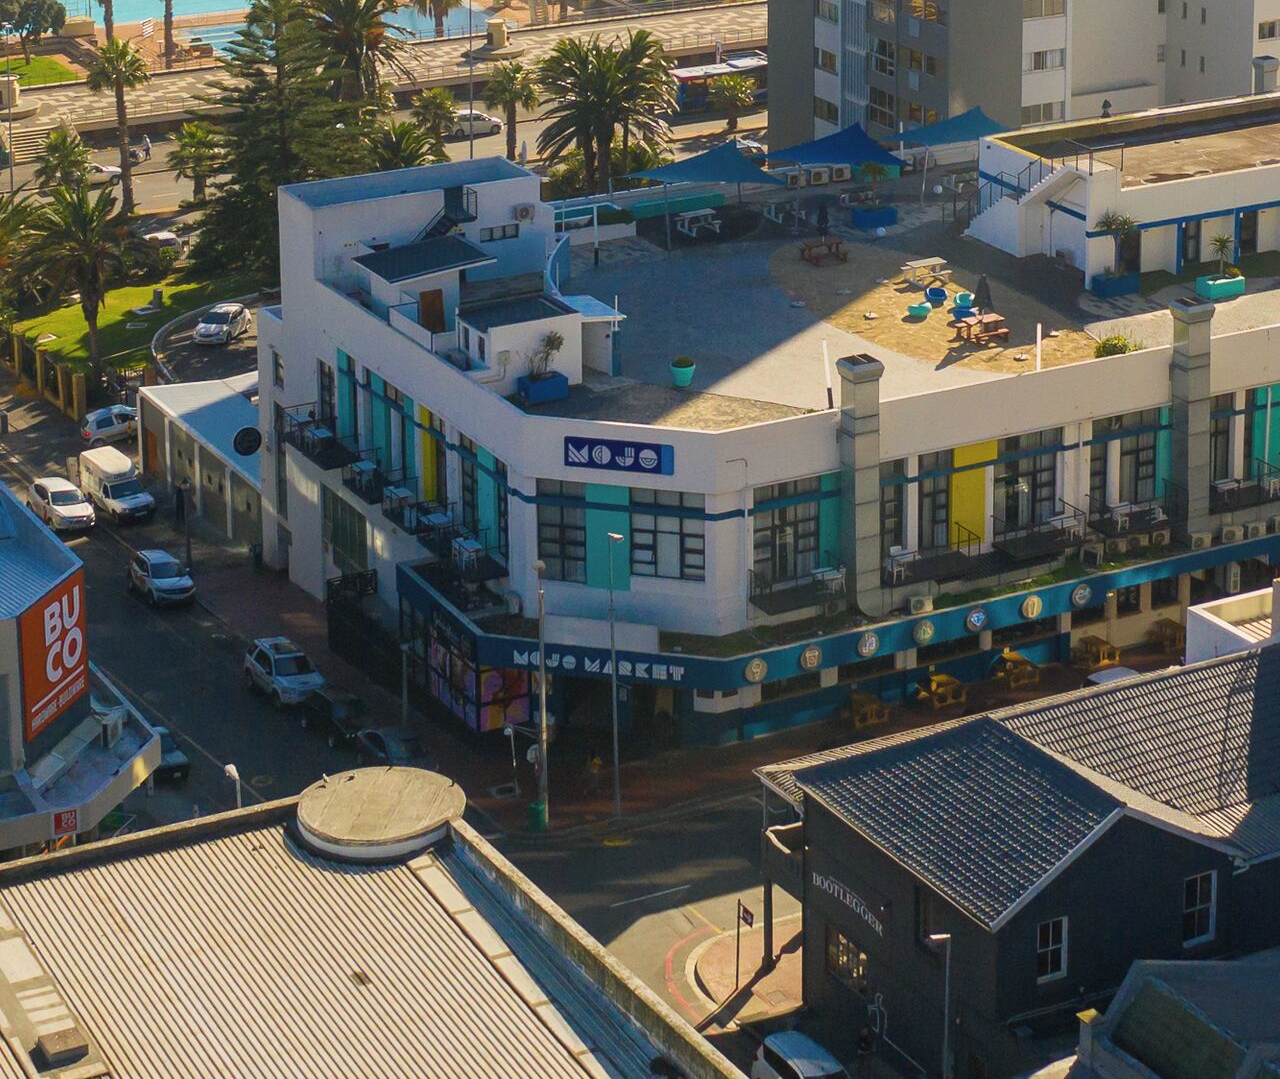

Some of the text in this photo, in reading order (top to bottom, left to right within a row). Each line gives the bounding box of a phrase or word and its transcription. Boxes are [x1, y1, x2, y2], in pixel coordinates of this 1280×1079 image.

[568, 442, 658, 469] MOJO
[43, 584, 80, 647] BU
[46, 626, 83, 683] CO
[513, 649, 685, 682] MOJO MARKET
[812, 872, 884, 938] BOOTLEGGER
